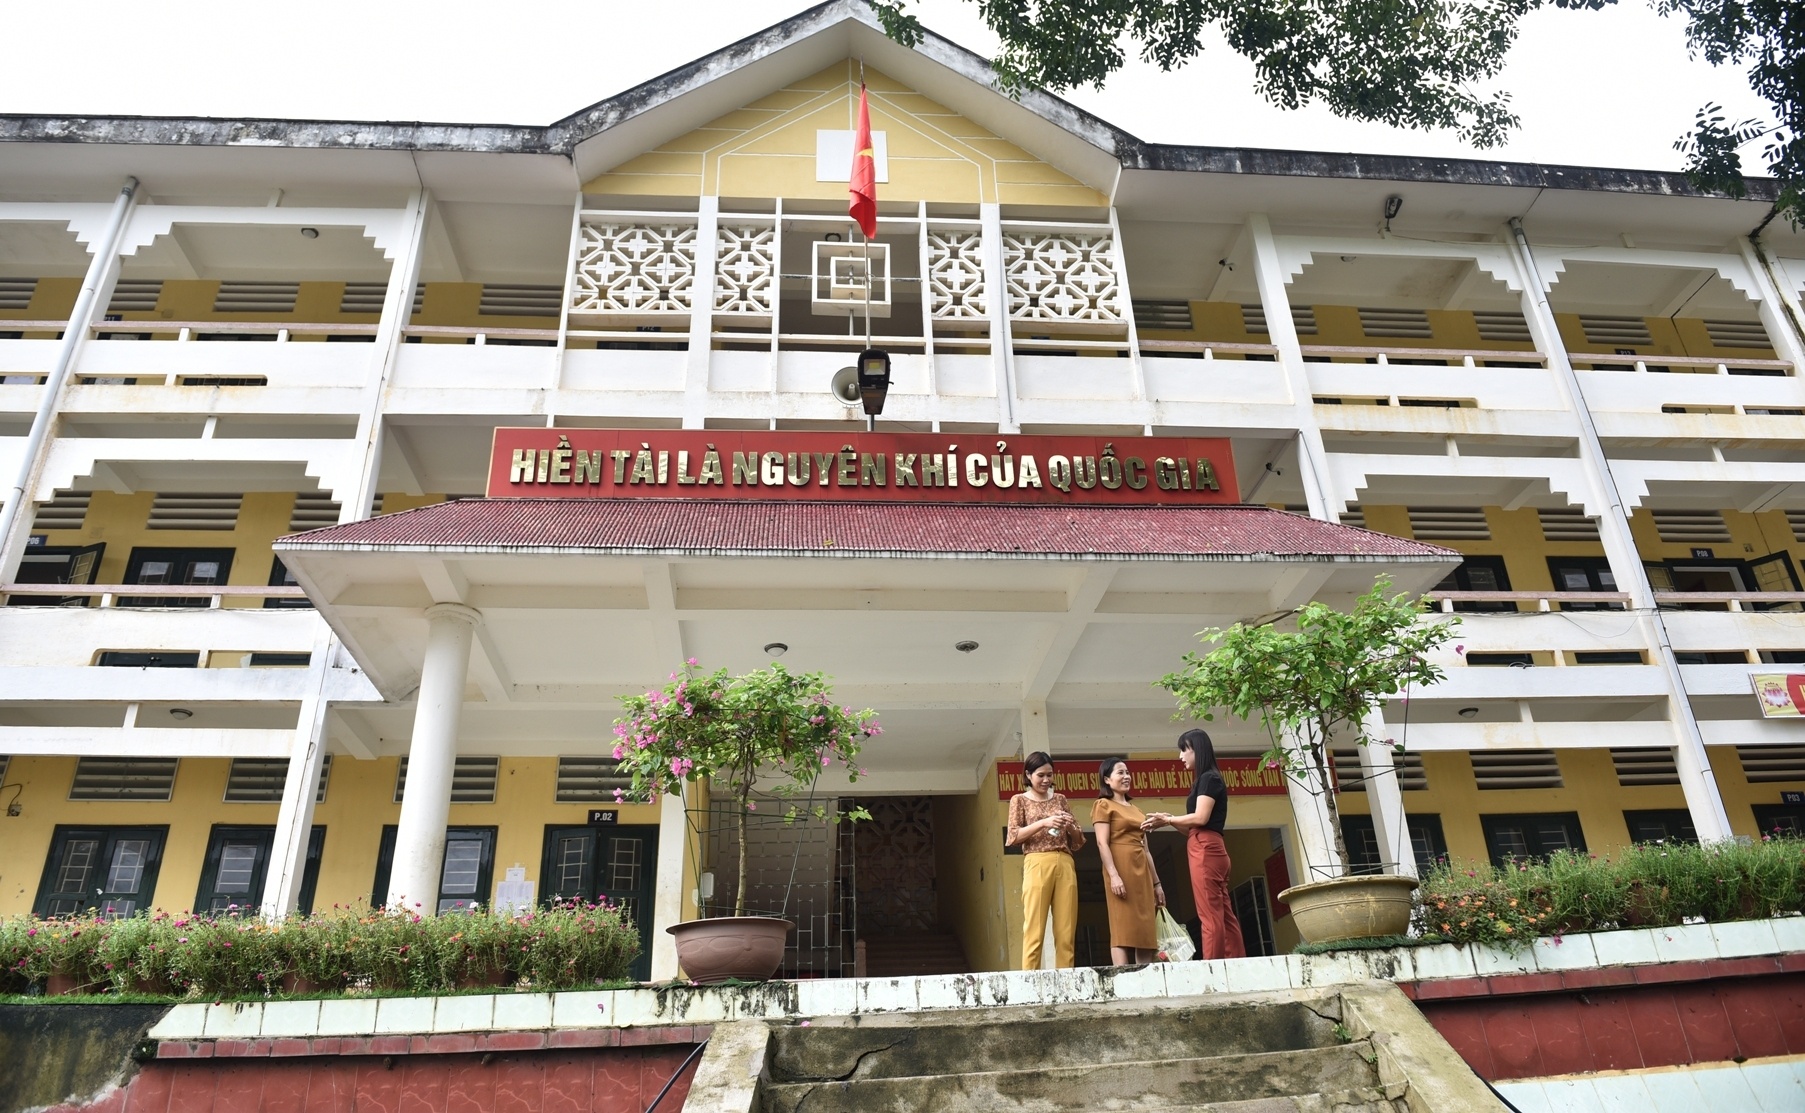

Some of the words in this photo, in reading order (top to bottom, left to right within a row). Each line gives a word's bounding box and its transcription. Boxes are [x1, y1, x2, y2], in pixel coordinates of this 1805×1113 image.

[509, 435, 602, 484] HIỀN
[610, 442, 670, 485] TÀI
[676, 443, 724, 486] LÀ
[732, 444, 887, 487] NGUYÊN
[894, 444, 959, 488] KHÍ
[965, 440, 1043, 489] CỦA
[1048, 442, 1148, 493] QUỐC
[1154, 455, 1220, 491] GIA
[999, 770, 1015, 792] HÃY
[1053, 769, 1066, 790] HÓI
[1067, 772, 1090, 792] QUEN
[1132, 771, 1148, 793] LẠC
[1149, 768, 1166, 793] HẬU
[1166, 764, 1178, 789] ĐỂ
[1240, 764, 1262, 788] SỐNG
[594, 812, 613, 821] P.02
